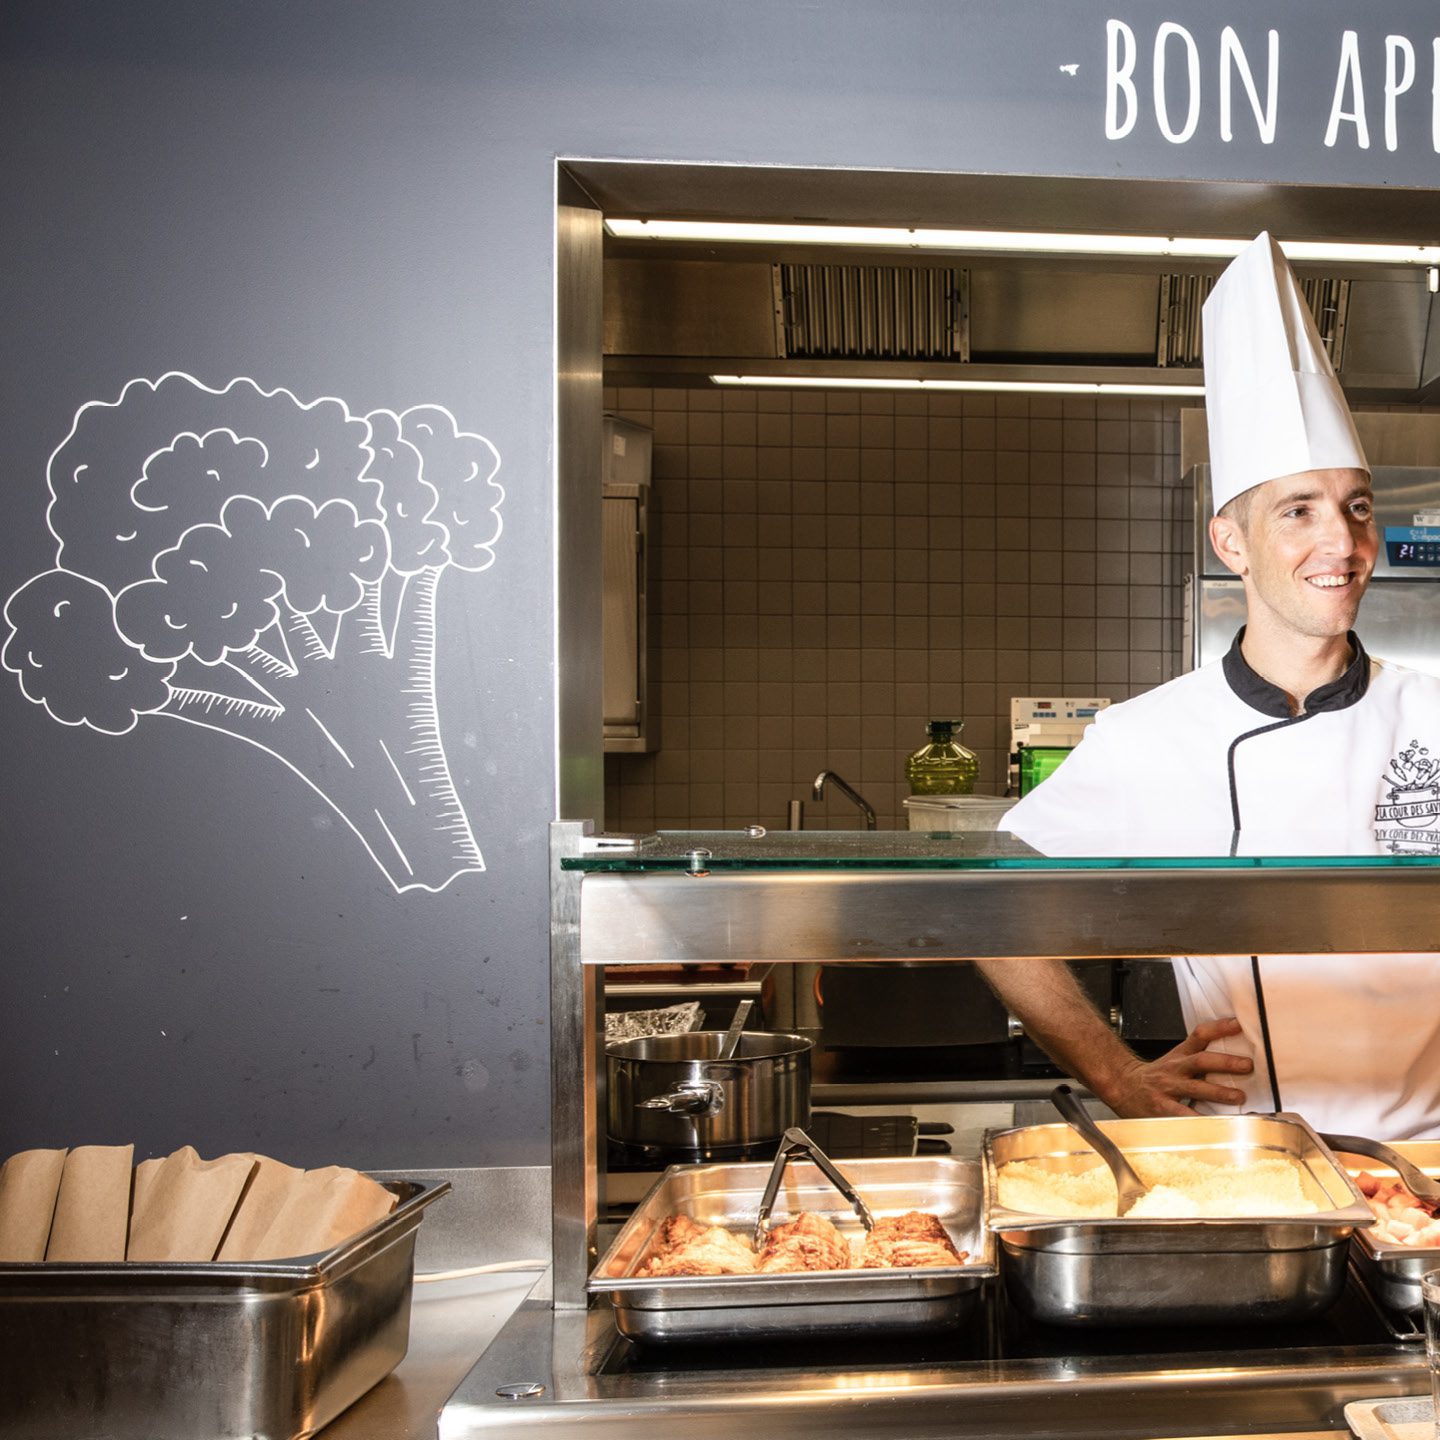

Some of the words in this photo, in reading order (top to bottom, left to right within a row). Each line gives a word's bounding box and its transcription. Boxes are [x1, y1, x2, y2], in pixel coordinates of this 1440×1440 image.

[1104, 18, 1280, 145] BON
[1380, 808, 1387, 819] LA
[1389, 806, 1409, 818] COUR
[1411, 804, 1424, 815] DES
